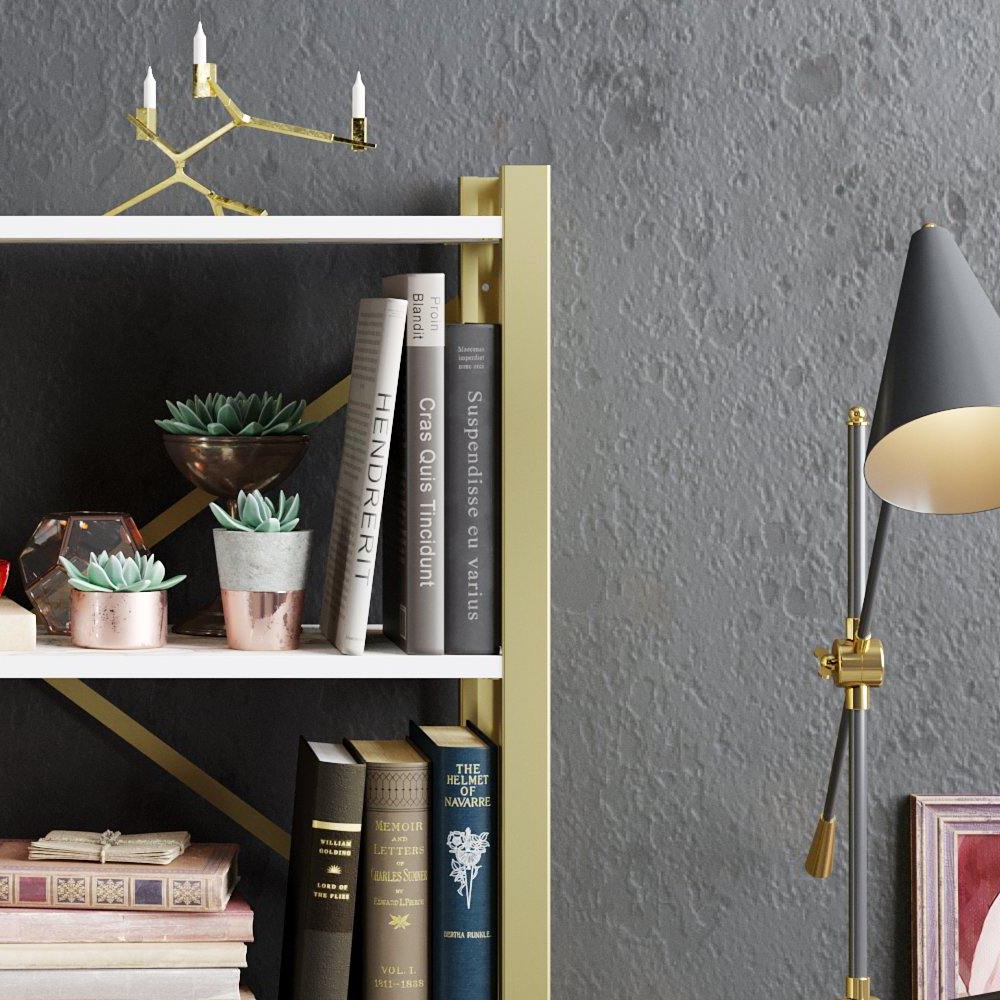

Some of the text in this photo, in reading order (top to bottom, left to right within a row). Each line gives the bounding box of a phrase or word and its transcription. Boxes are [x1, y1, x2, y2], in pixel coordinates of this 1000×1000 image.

[412, 292, 424, 341] Blandit
[430, 296, 441, 332] Proin
[355, 392, 393, 586] HENDRERIT
[419, 397, 436, 588] Cras Quis Tincidunt
[467, 391, 483, 622] Suspendisse eu varius
[455, 763, 481, 774] THE
[446, 774, 489, 785] HELMET
[460, 785, 476, 796] OF
[444, 796, 491, 808] NAVARRE
[375, 821, 424, 832] MEMOIR
[320, 839, 352, 847] WILLIAM
[318, 849, 352, 857] GOLDING
[373, 843, 424, 856] LETTERS
[313, 891, 327, 899] THE
[381, 966, 406, 975] VOL.
